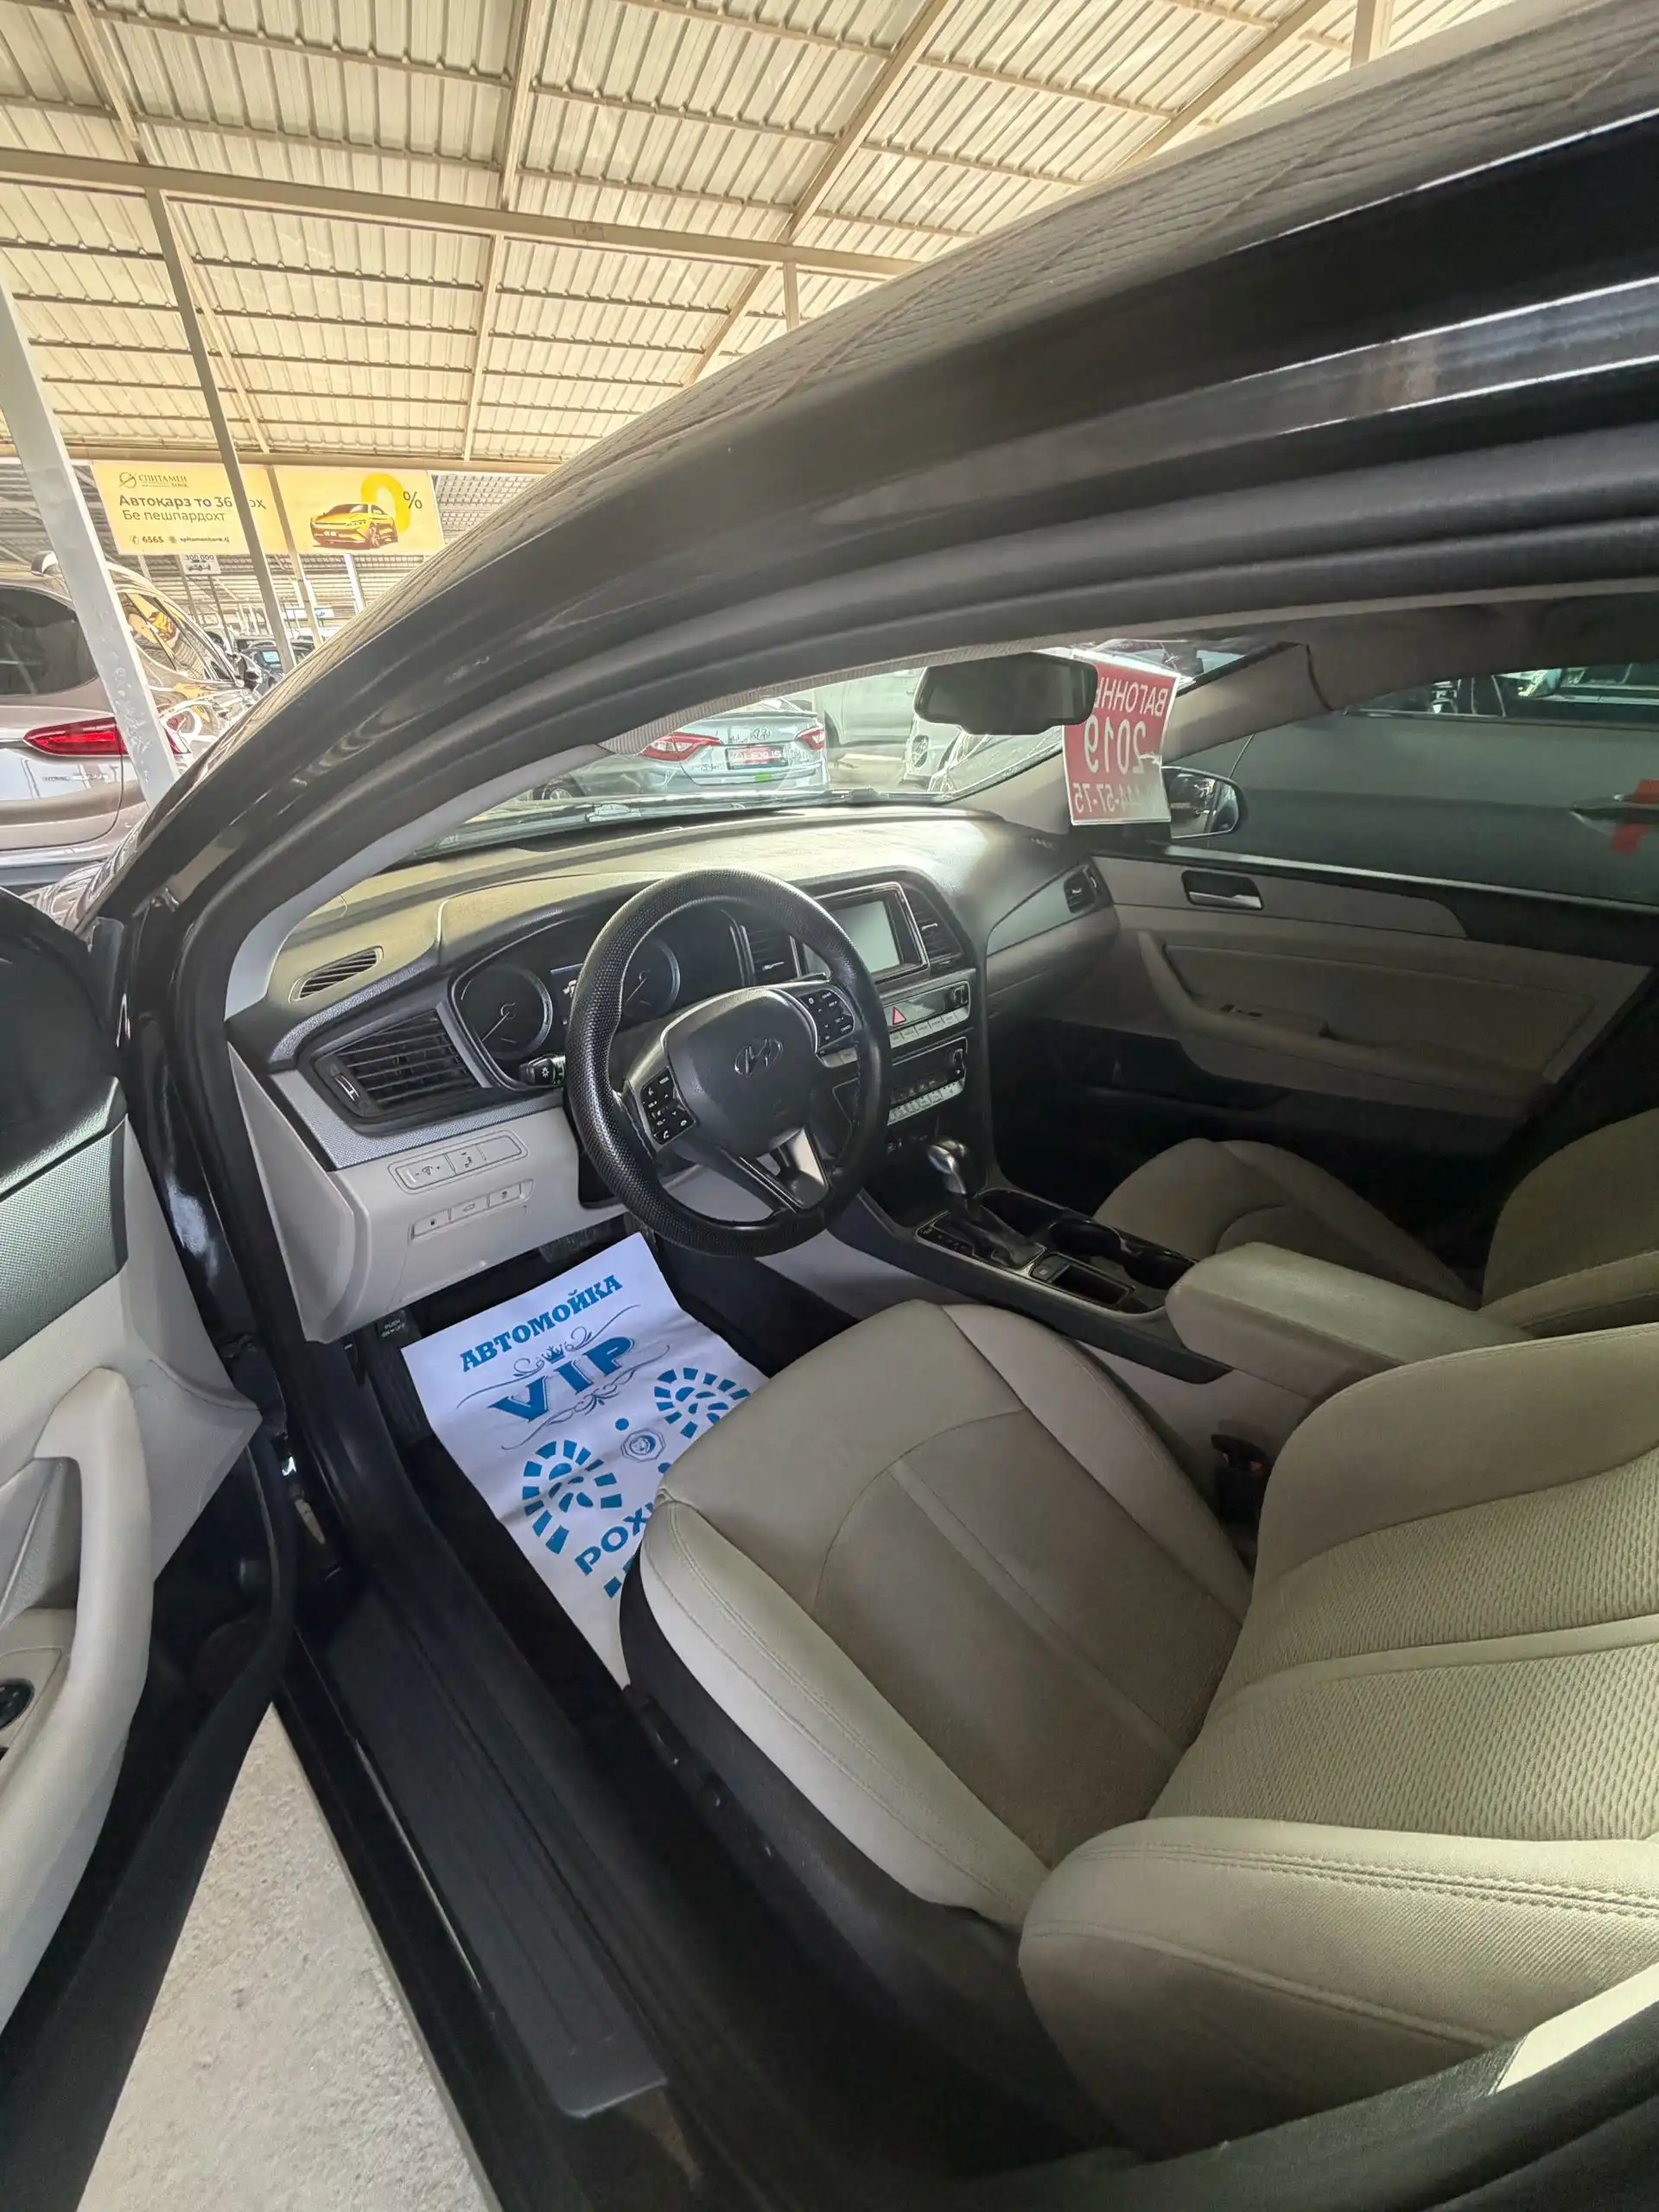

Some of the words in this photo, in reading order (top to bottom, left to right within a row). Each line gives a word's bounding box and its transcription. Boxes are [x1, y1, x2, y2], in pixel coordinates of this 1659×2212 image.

[123, 510, 141, 520] Бе
[143, 512, 226, 524] пешпардохт
[194, 499, 213, 508] то
[214, 496, 233, 508] 36
[459, 1274, 623, 1372] АВТОМОЙКА
[488, 1335, 638, 1423] VIP
